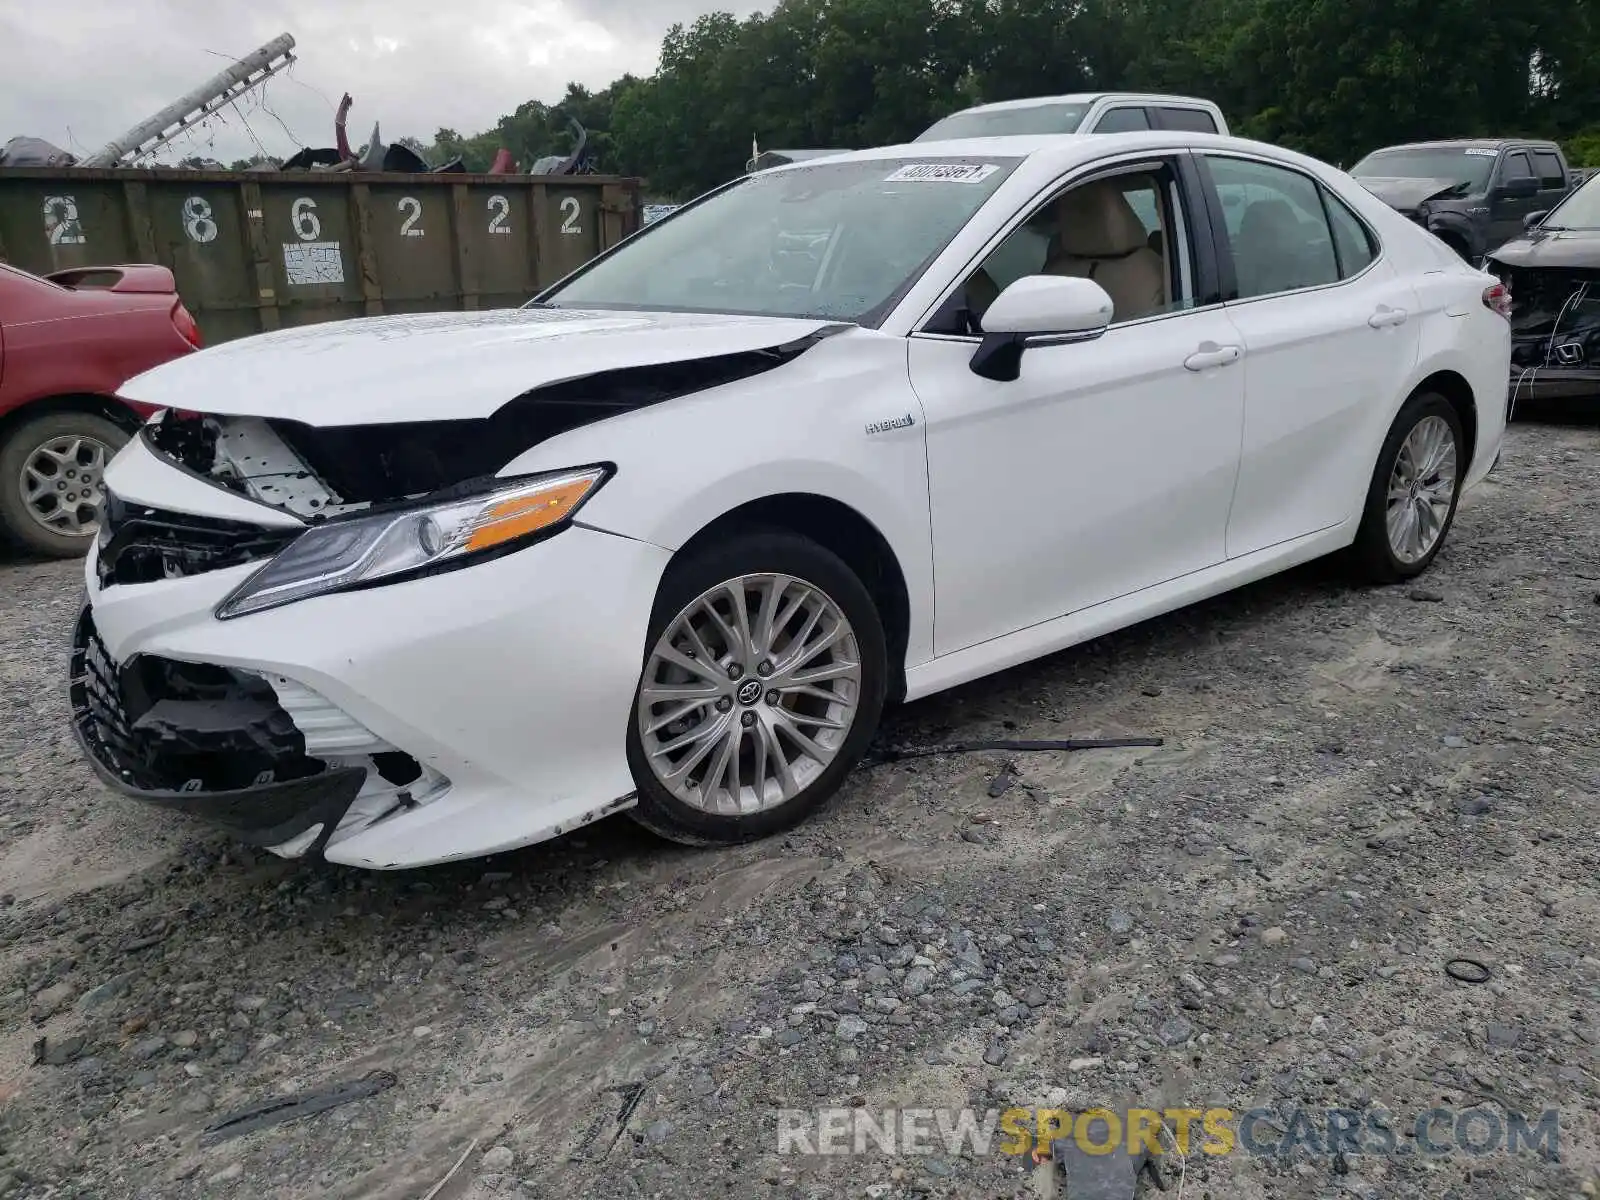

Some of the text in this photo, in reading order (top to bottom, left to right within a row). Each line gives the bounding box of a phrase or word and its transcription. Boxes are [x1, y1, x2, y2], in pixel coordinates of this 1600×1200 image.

[182, 196, 218, 243] 8
[291, 197, 322, 241] 6
[398, 196, 425, 236] 2
[487, 195, 511, 234] 2
[560, 197, 582, 234] 2
